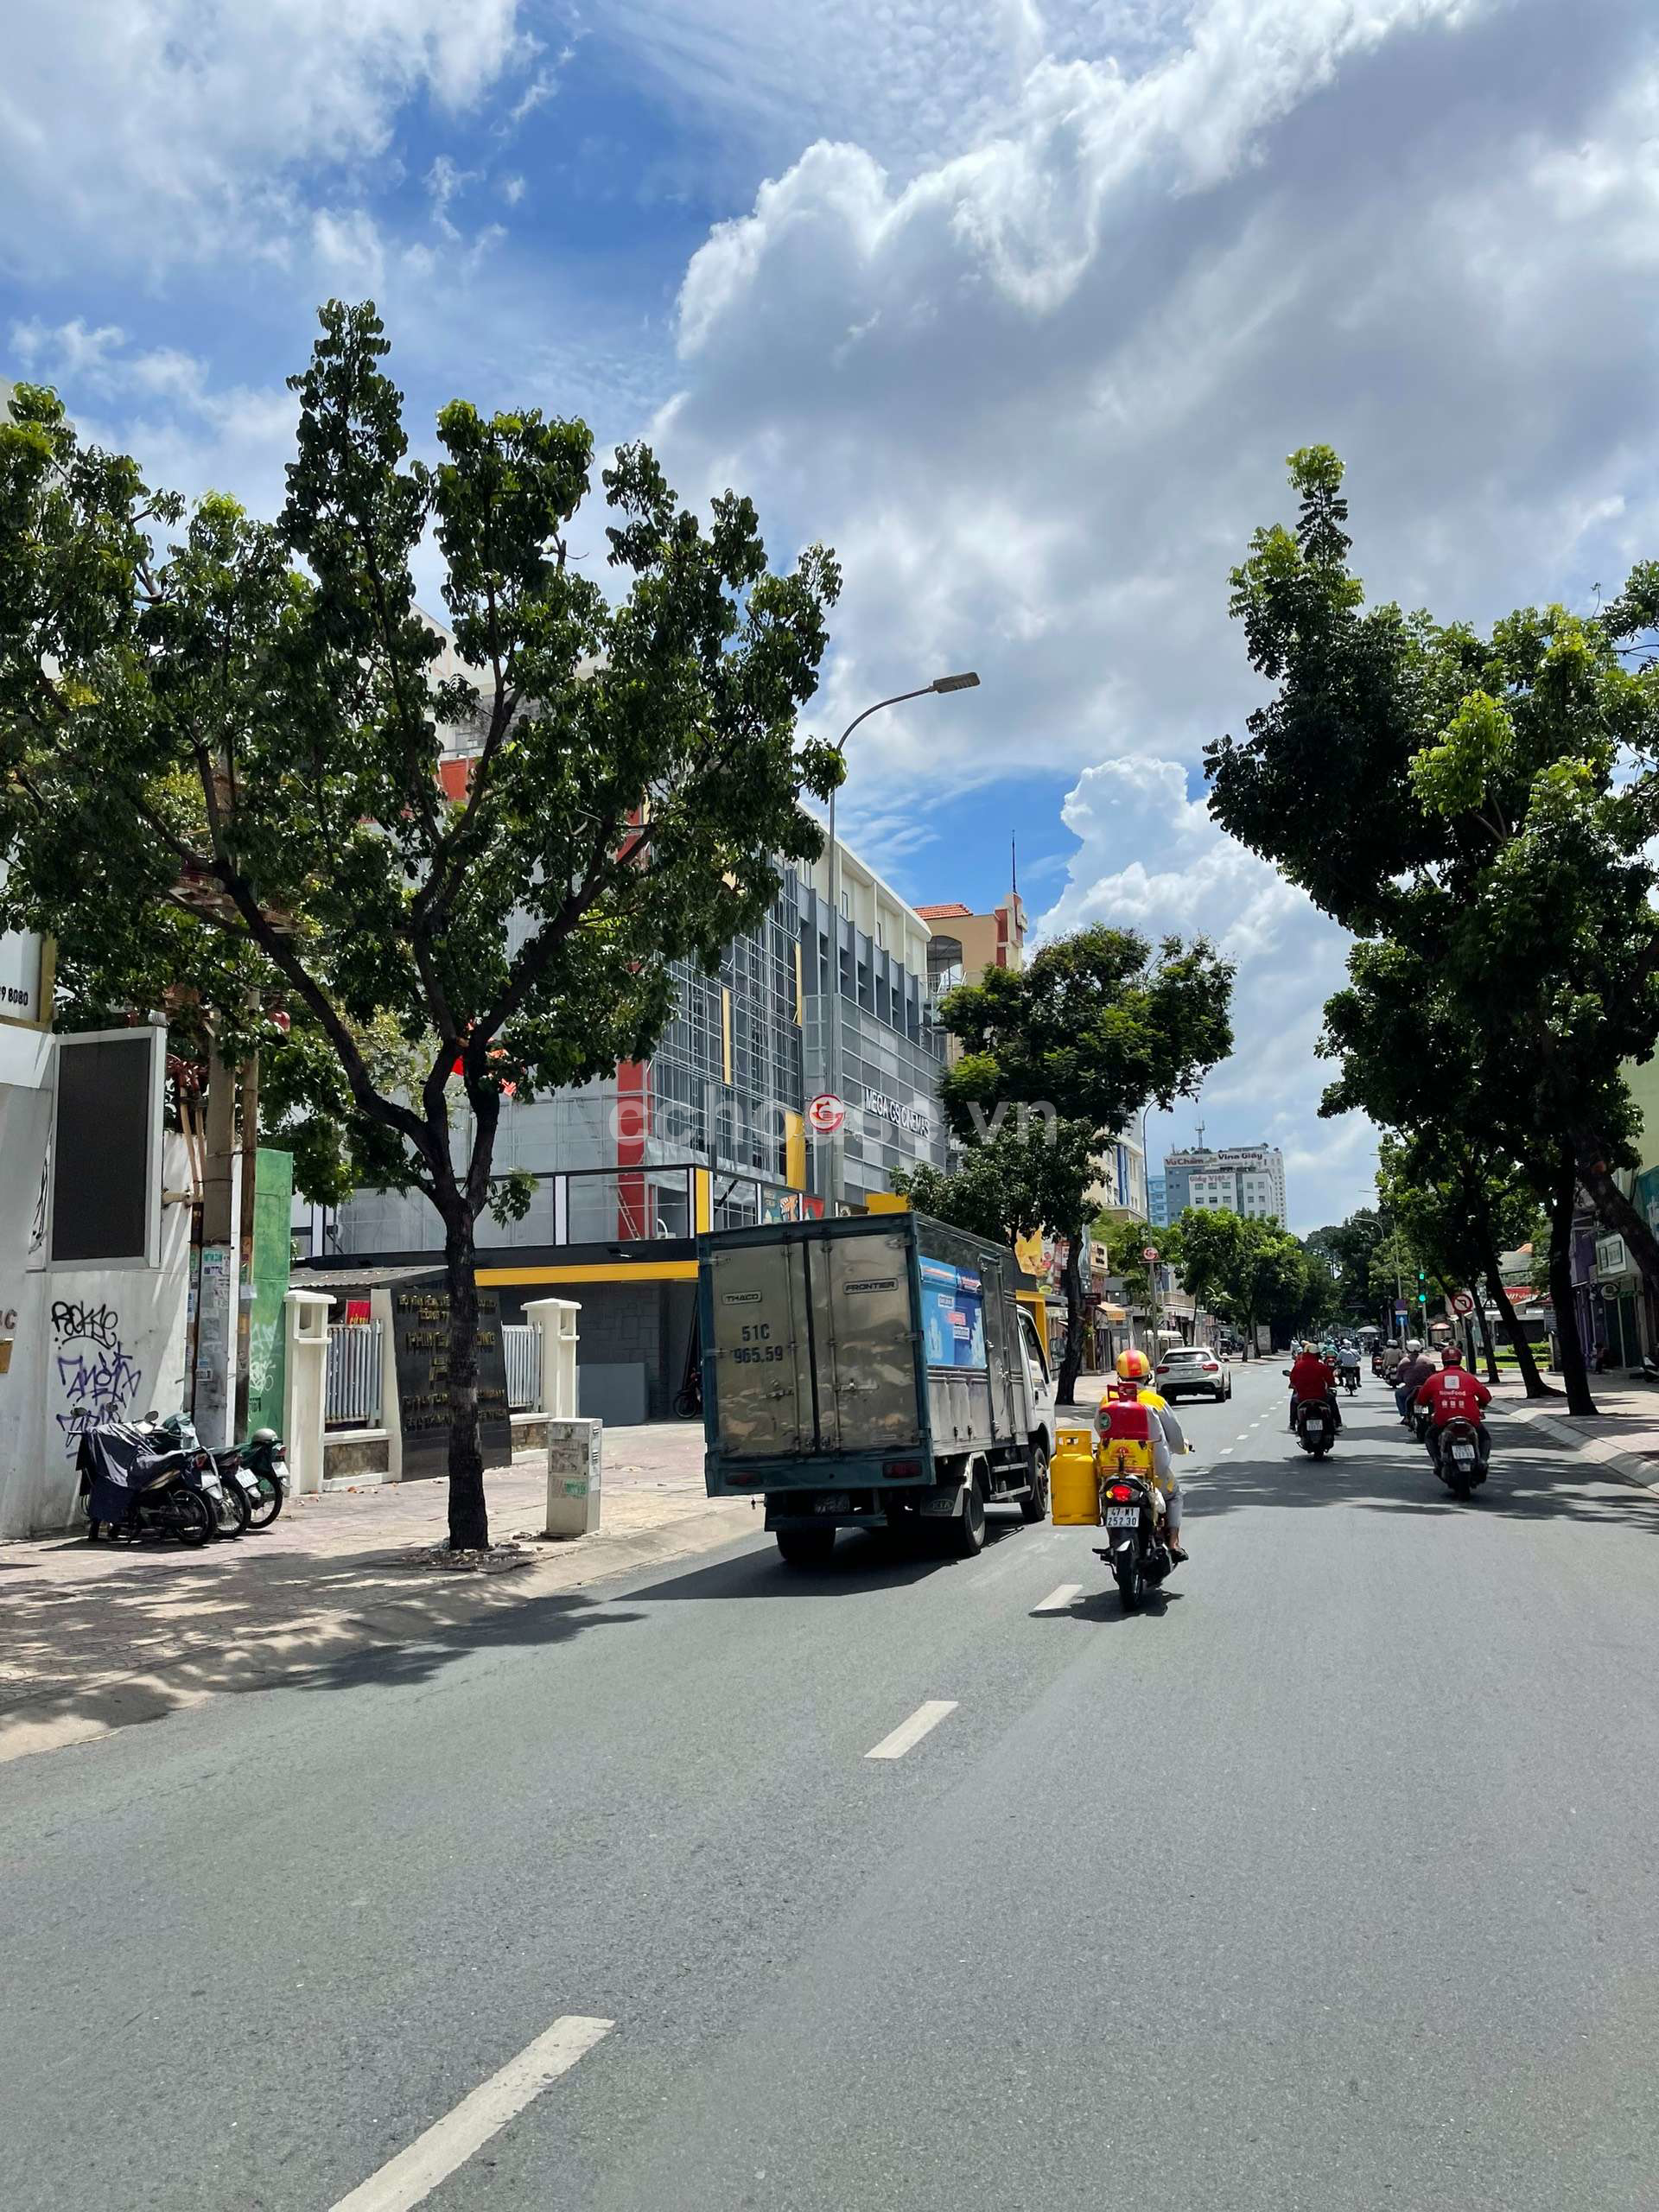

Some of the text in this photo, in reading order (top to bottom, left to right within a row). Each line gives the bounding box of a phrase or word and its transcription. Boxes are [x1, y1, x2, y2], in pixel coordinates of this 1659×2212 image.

[8, 988, 29, 1006] 8080
[865, 1088, 931, 1139] MEGA GS CINEMAS
[845, 1281, 896, 1292] FRONTIER
[726, 1293, 760, 1302] THACO
[741, 1323, 770, 1342] 51C
[734, 1345, 783, 1364] 965.59
